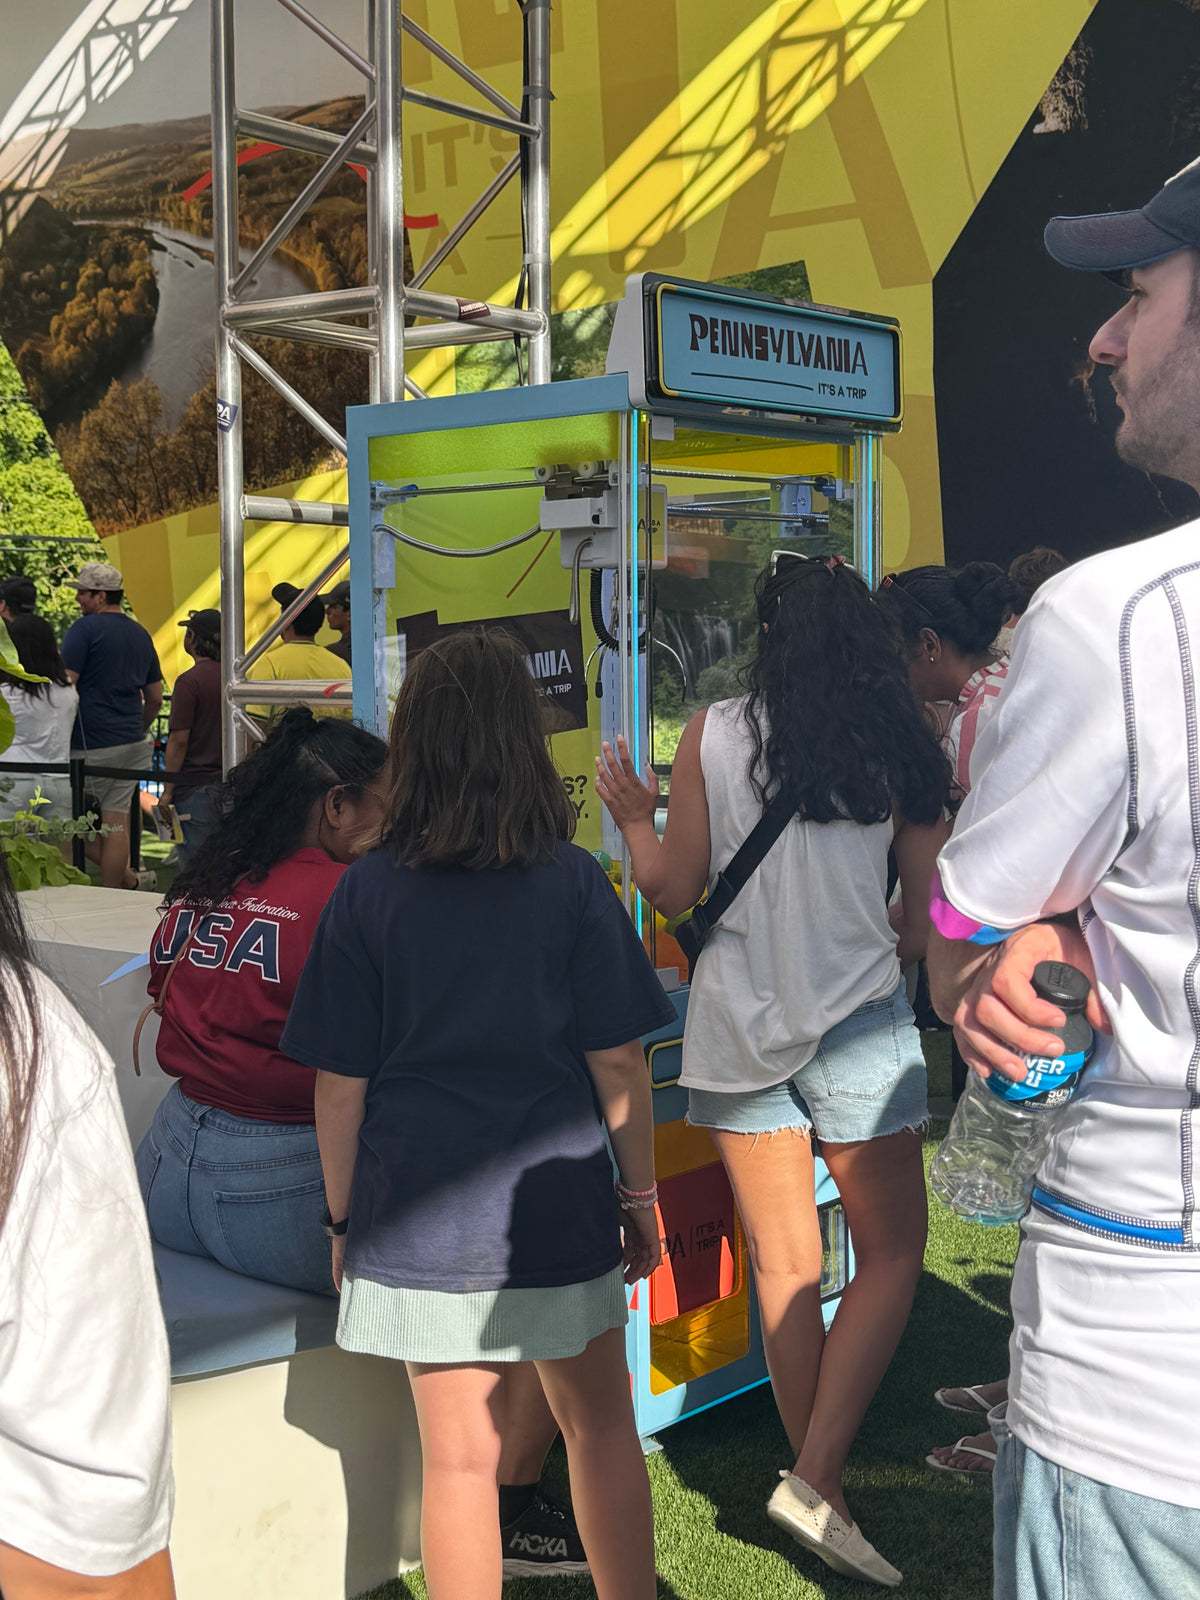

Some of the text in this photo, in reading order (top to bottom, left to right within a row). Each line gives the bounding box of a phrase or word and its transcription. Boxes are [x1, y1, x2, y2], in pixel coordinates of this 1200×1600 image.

[688, 313, 869, 376] PENNSYLVANIA
[818, 382, 867, 399] IT'S A TRIP
[546, 686, 553, 696] A
[553, 683, 572, 694] TRIP
[562, 775, 588, 796] S?
[571, 799, 589, 819] Y.
[237, 896, 302, 922] Federation
[154, 909, 281, 984] USA
[509, 1531, 568, 1557] HOKA
